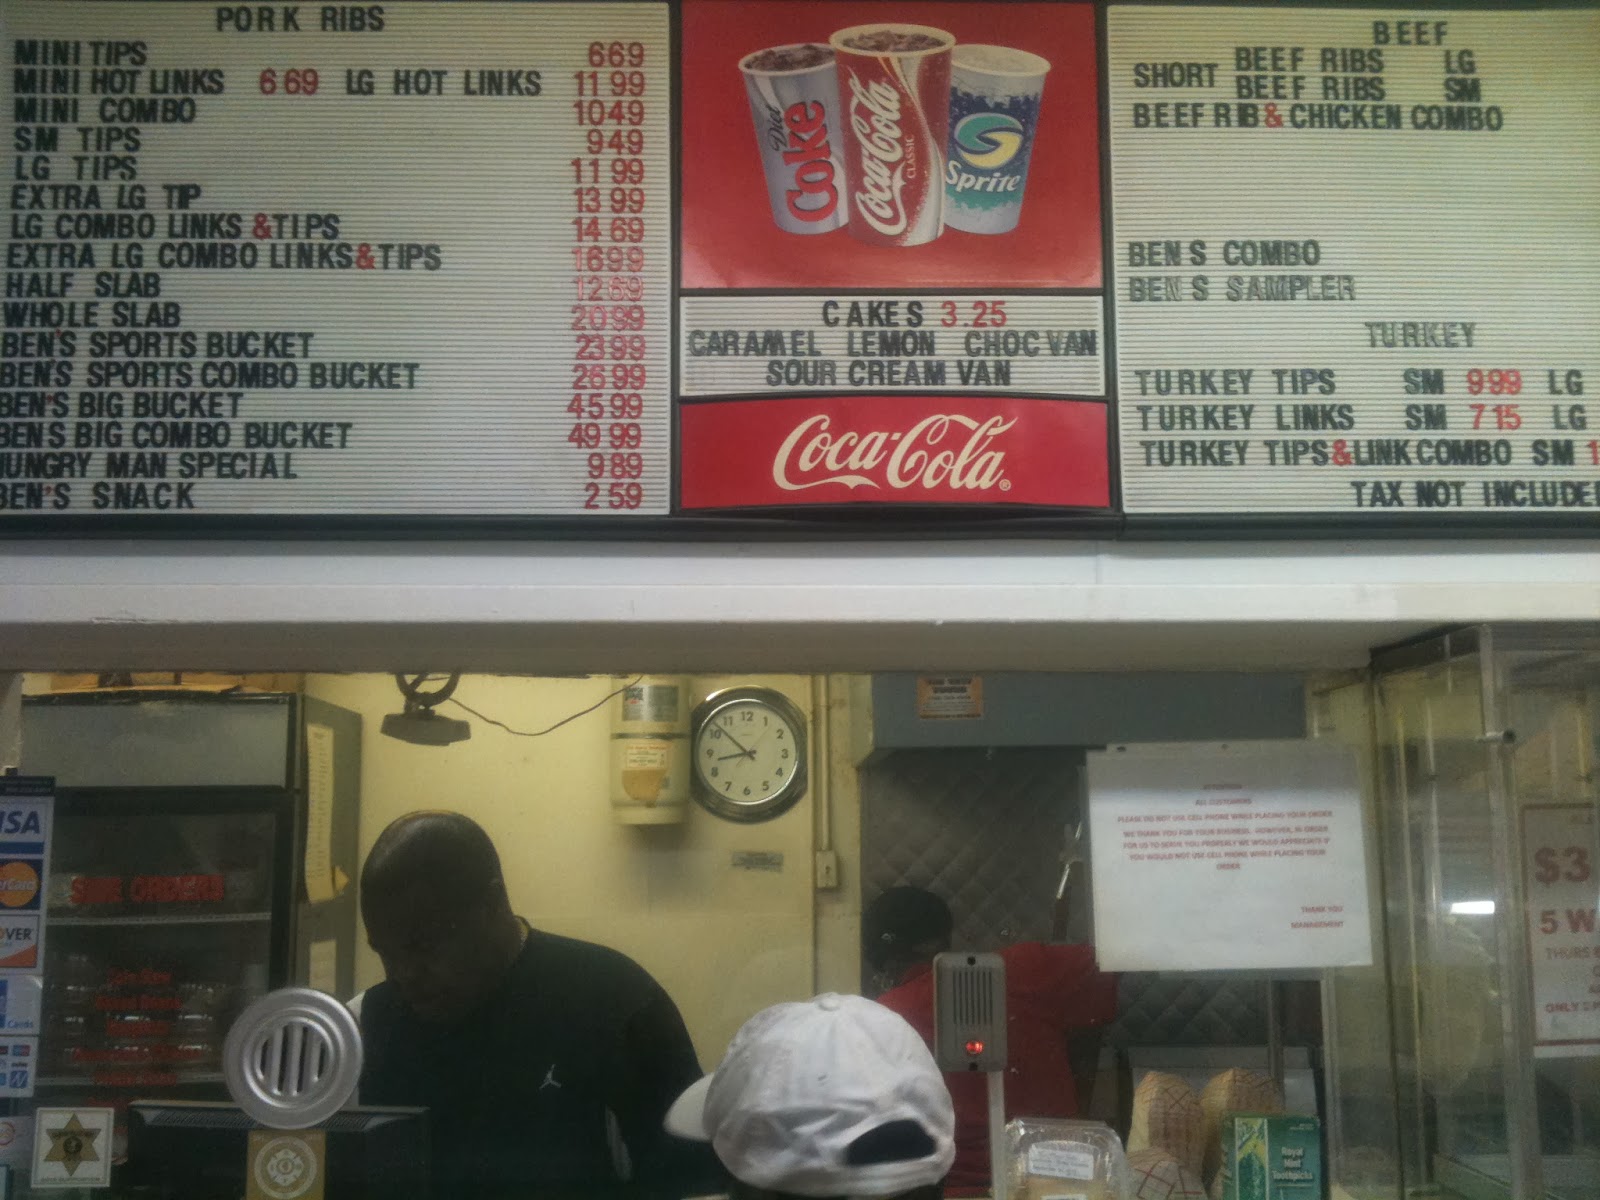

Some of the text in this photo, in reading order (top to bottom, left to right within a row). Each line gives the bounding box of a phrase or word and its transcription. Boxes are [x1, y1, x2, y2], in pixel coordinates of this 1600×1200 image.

[216, 6, 385, 32] PORK RIBS
[1372, 21, 1448, 46] BEEF
[14, 40, 80, 65] MINI
[89, 40, 147, 66] TIPS
[1235, 47, 1476, 75] BEEF RIBS LG
[14, 68, 79, 94] MINI
[91, 68, 142, 94] HOT
[151, 68, 224, 94] LINKS
[345, 69, 375, 95] LG
[394, 69, 447, 95] HOT
[465, 69, 541, 95] LINKS
[1134, 63, 1481, 103] SHORT BEEF RIBS SM
[14, 98, 78, 122] MINI
[100, 98, 196, 123] COMBO
[1134, 103, 1205, 129] BEEF
[1411, 105, 1502, 131] COMBO
[14, 126, 58, 151] SM
[77, 126, 141, 151] TIPS
[15, 155, 50, 180] LG
[73, 156, 137, 181] TIPS
[785, 100, 839, 222] Coke
[905, 135, 915, 180] CLASSIC
[946, 160, 1021, 193] Sprite
[10, 184, 101, 210] EXTRA
[117, 184, 146, 210] LG
[163, 184, 201, 210] TIP
[11, 214, 43, 239] LG
[55, 213, 155, 239] COMBO
[168, 213, 242, 239] LINKS
[6, 242, 95, 268] EXTRA
[111, 242, 143, 268] LG
[158, 242, 258, 268] COMBO
[1223, 240, 1321, 267] COMBO
[6, 272, 74, 297] HALF
[95, 271, 160, 298] SLAB
[1227, 275, 1355, 302] SAMPLER
[3, 302, 99, 327] WHOLE
[112, 302, 181, 327] SLAB
[822, 300, 1007, 328] CAKES 3.25
[89, 331, 197, 358] SPORTS
[206, 331, 314, 358] BUCKET
[687, 330, 1097, 357] CARAMEL LEMON CHOC VAN
[1364, 321, 1476, 348] TURKEY
[87, 360, 193, 388] SPORTS
[201, 361, 298, 388] COMBO
[309, 362, 420, 388] BUCKET
[766, 360, 1011, 387] SOUR CREAM VAN
[1135, 369, 1254, 395] TURKEY
[1272, 369, 1336, 395] TIPS
[1404, 368, 1445, 395] SM
[1548, 369, 1584, 395] LG
[78, 392, 124, 418] BIG
[133, 392, 243, 418] BUCKET
[1137, 404, 1255, 431] TURKEY
[1275, 404, 1355, 431] LINKS
[1405, 404, 1447, 431] SM
[1553, 404, 1587, 431] LG
[75, 421, 122, 448] BIG
[132, 421, 232, 448] COMBO
[245, 421, 352, 448] BUCKET
[106, 452, 167, 478] MAN
[178, 452, 297, 479] SPECIAL
[1140, 439, 1249, 466] TURKEY
[1417, 439, 1512, 466] COMBO
[1531, 439, 1575, 466] SM
[93, 481, 195, 509] SNACK
[1350, 480, 1600, 508] TAX NOT INCLUDE
[723, 716, 733, 726] 11
[741, 711, 754, 721] 12
[763, 716, 768, 726] 1
[709, 729, 721, 739] 10
[776, 729, 784, 739] 2
[706, 749, 714, 758] 9
[781, 749, 788, 759] 3
[711, 767, 718, 777] 8
[776, 768, 783, 777] 4
[724, 782, 732, 791] 7
[743, 786, 751, 795] 6
[763, 781, 770, 791] 5
[1540, 909, 1558, 934] 5
